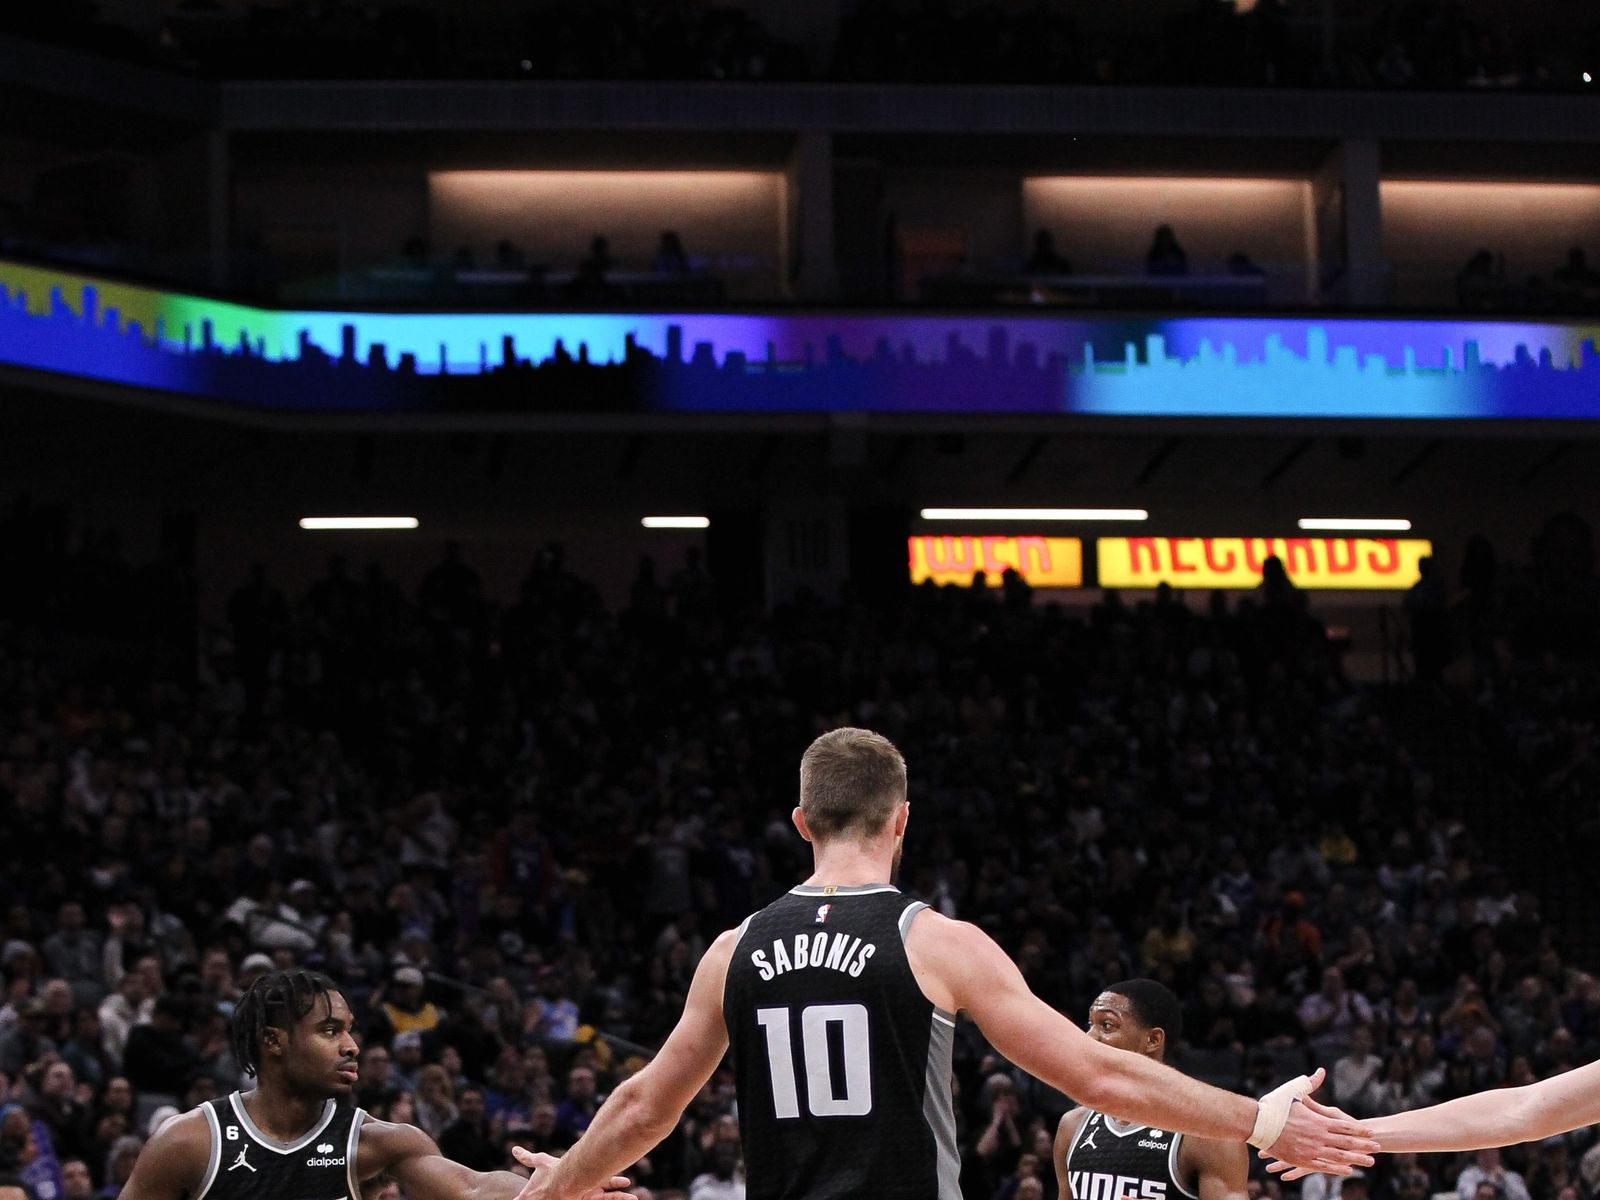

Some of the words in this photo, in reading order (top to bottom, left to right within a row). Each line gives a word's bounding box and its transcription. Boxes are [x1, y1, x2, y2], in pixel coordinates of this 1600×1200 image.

[751, 932, 876, 981] SABONIS
[757, 1004, 872, 1119] 10
[226, 1125, 239, 1140] 6
[1138, 1139, 1168, 1150] dialpad
[307, 1156, 345, 1168] dialpad
